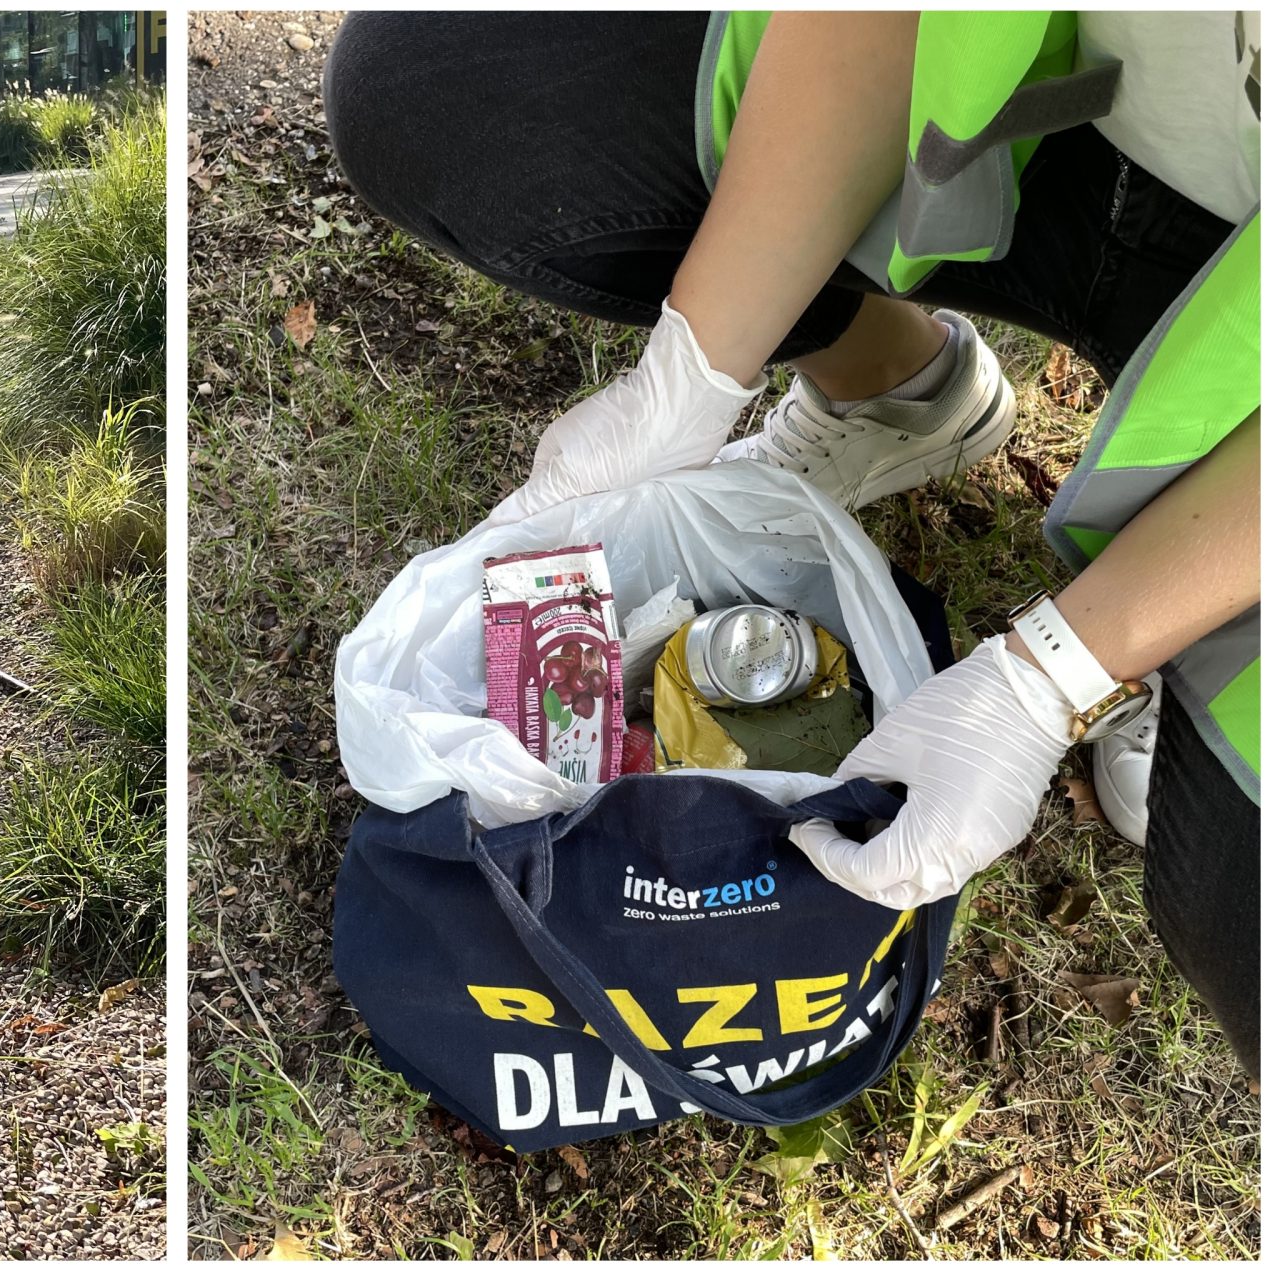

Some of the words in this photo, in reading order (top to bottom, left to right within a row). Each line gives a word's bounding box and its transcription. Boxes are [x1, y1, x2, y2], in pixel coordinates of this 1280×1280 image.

[524, 686, 540, 714] HAYATA
[524, 715, 541, 741] BAŞKA
[623, 865, 776, 909] interzero
[623, 906, 655, 920] zero
[657, 911, 706, 922] waste
[709, 901, 781, 919] solutions
[493, 1052, 658, 1131] DLA
